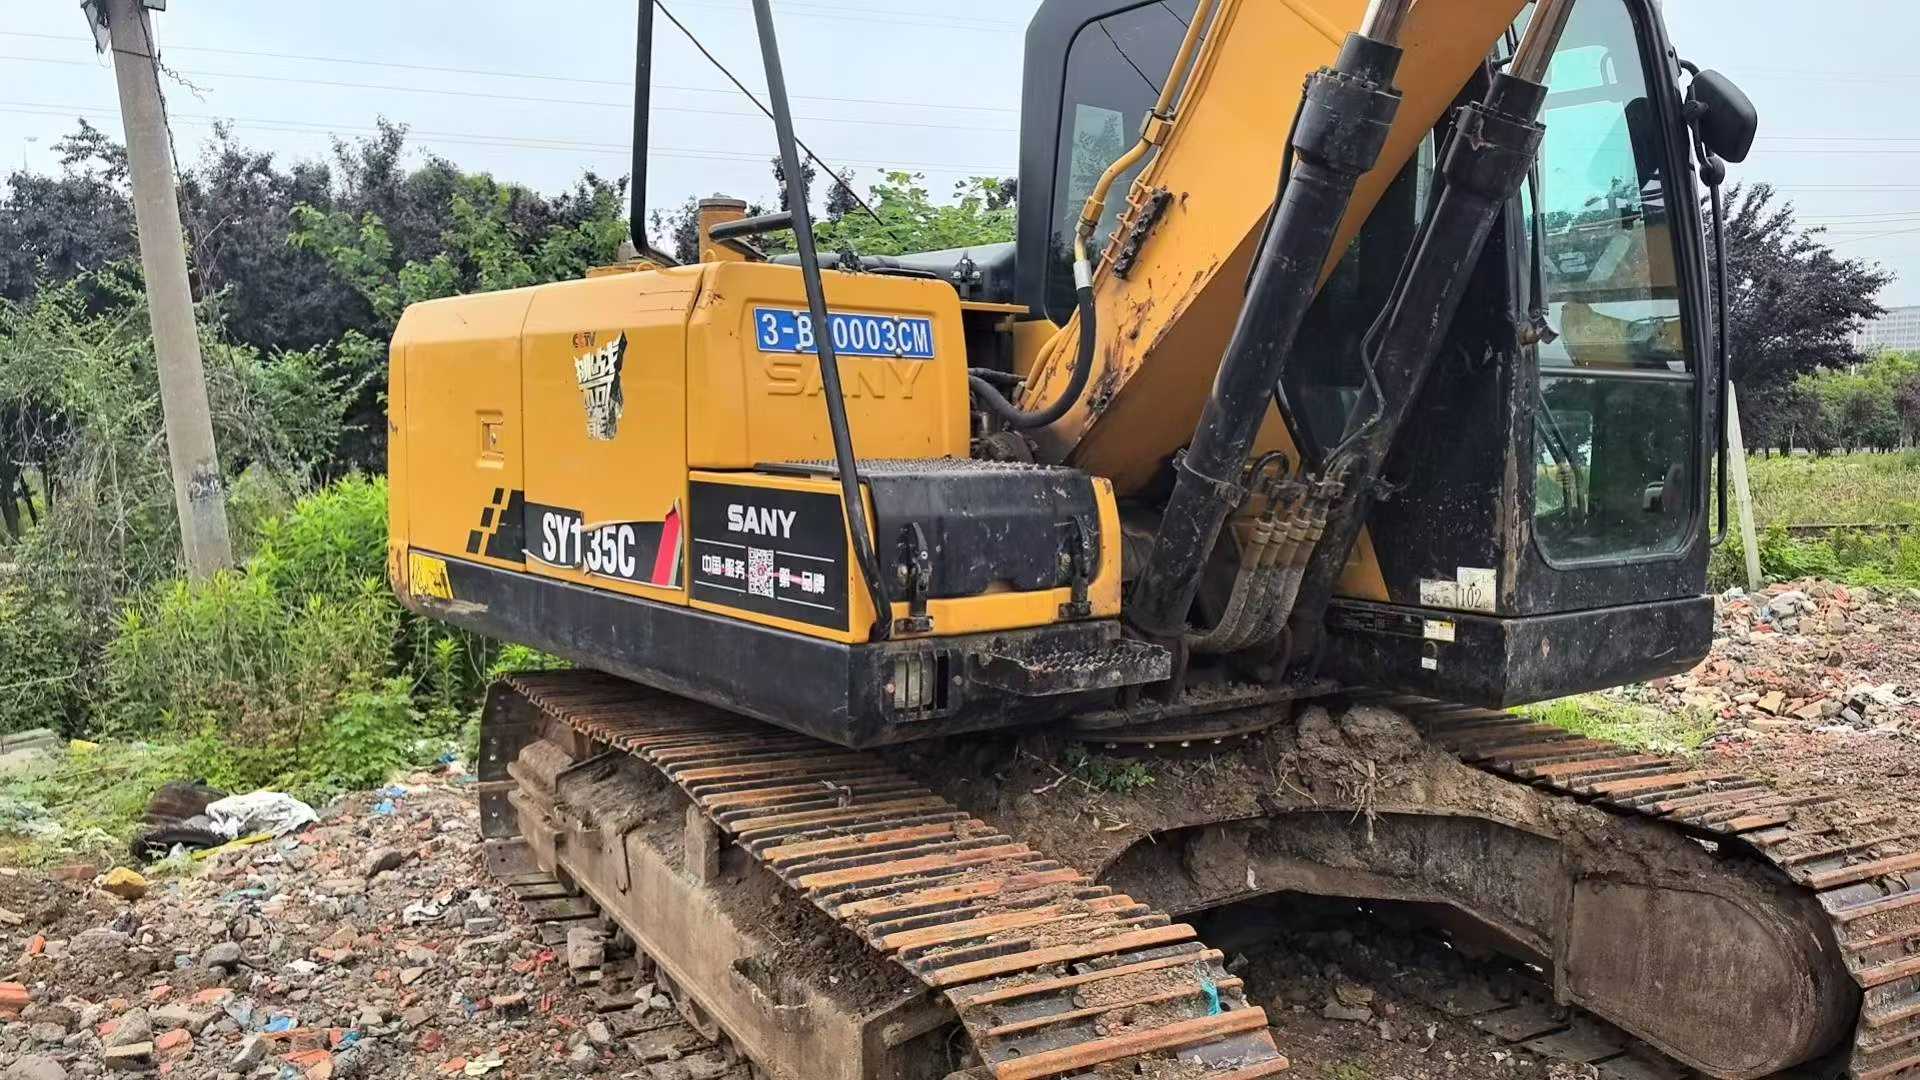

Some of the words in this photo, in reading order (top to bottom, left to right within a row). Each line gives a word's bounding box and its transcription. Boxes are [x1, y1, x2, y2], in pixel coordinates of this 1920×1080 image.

[761, 313, 929, 353] 3-B0003CM
[727, 503, 797, 539] SANY
[541, 511, 636, 578] SY135C
[1461, 587, 1482, 609] 102
